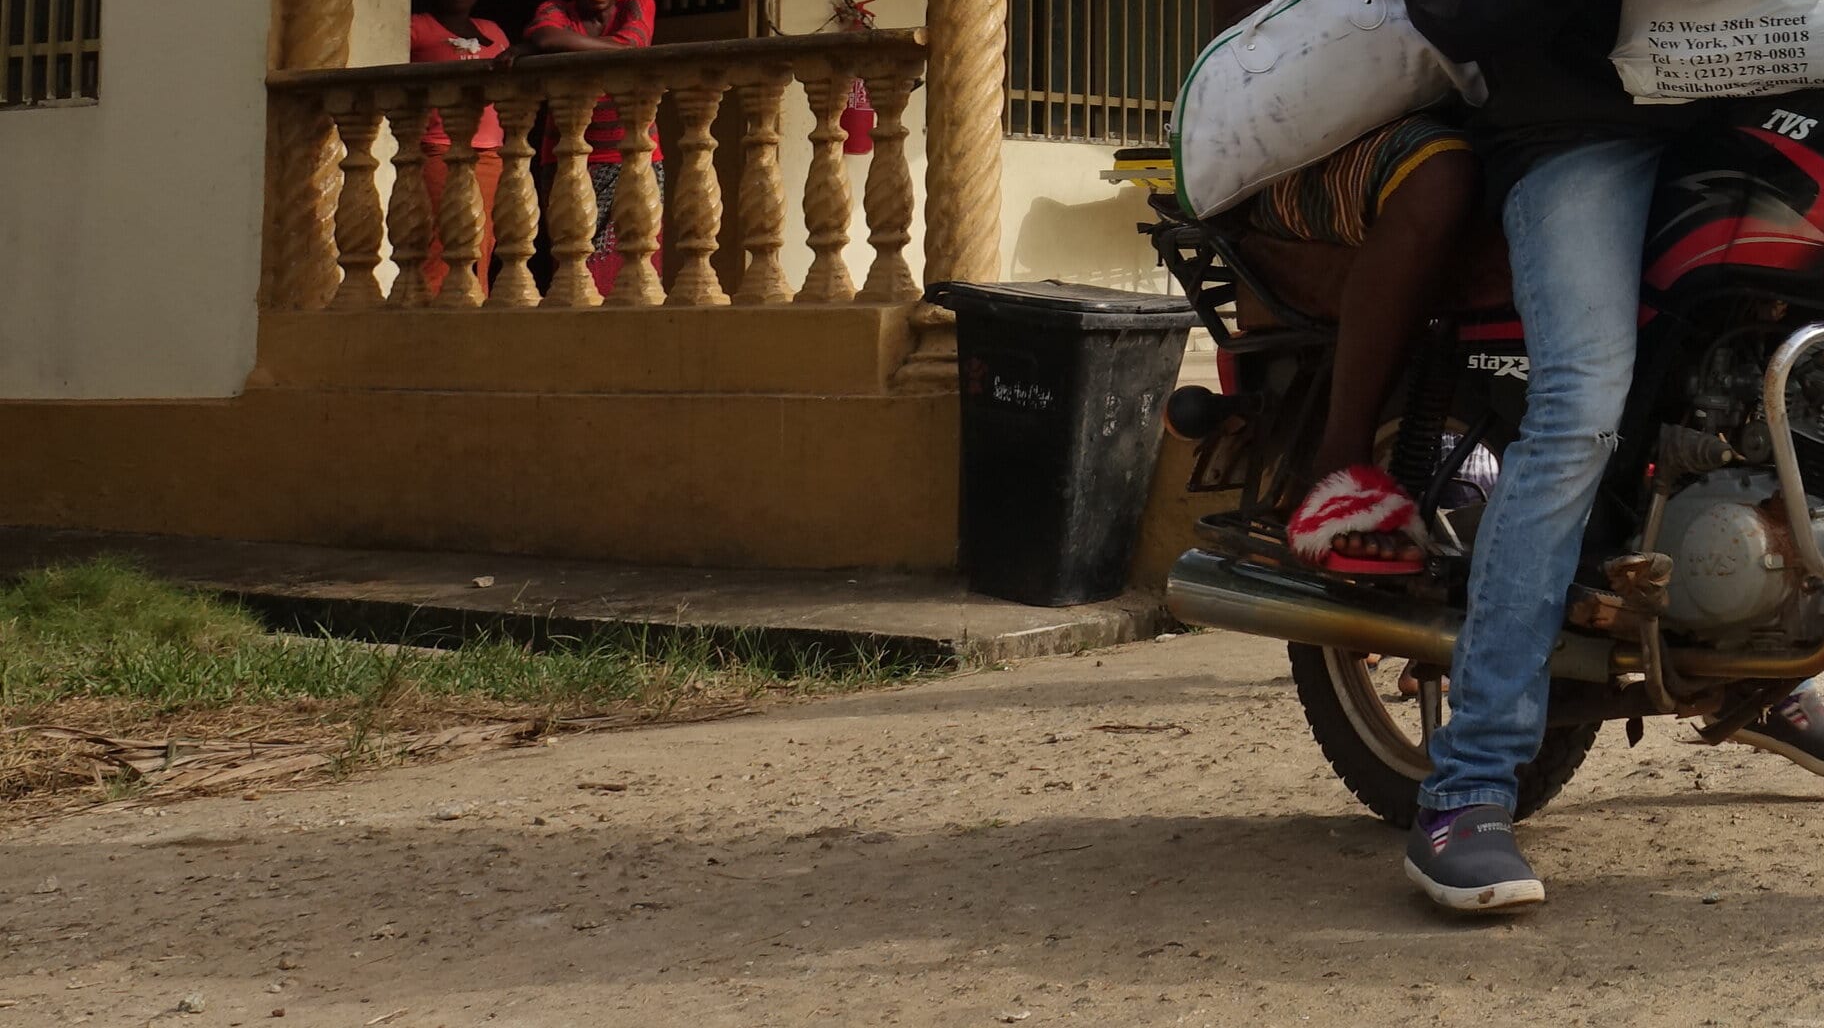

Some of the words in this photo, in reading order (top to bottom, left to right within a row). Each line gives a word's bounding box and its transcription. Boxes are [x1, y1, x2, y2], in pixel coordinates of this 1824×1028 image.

[1649, 21, 1674, 32] 263
[1679, 21, 1716, 32] West
[1720, 18, 1754, 31] 38th
[1760, 15, 1807, 27] Street
[1648, 37, 1681, 49] New
[1685, 38, 1728, 49] York,
[1732, 34, 1758, 46] NY
[1764, 30, 1809, 44] 10018
[1649, 53, 1671, 64] Tel
[1690, 53, 1730, 66] (212)
[1735, 47, 1806, 62] 278-0803
[1655, 66, 1681, 78] Fax
[1694, 67, 1733, 80] (212)
[1739, 62, 1808, 76] 278-0837
[1761, 108, 1818, 140] TVS
